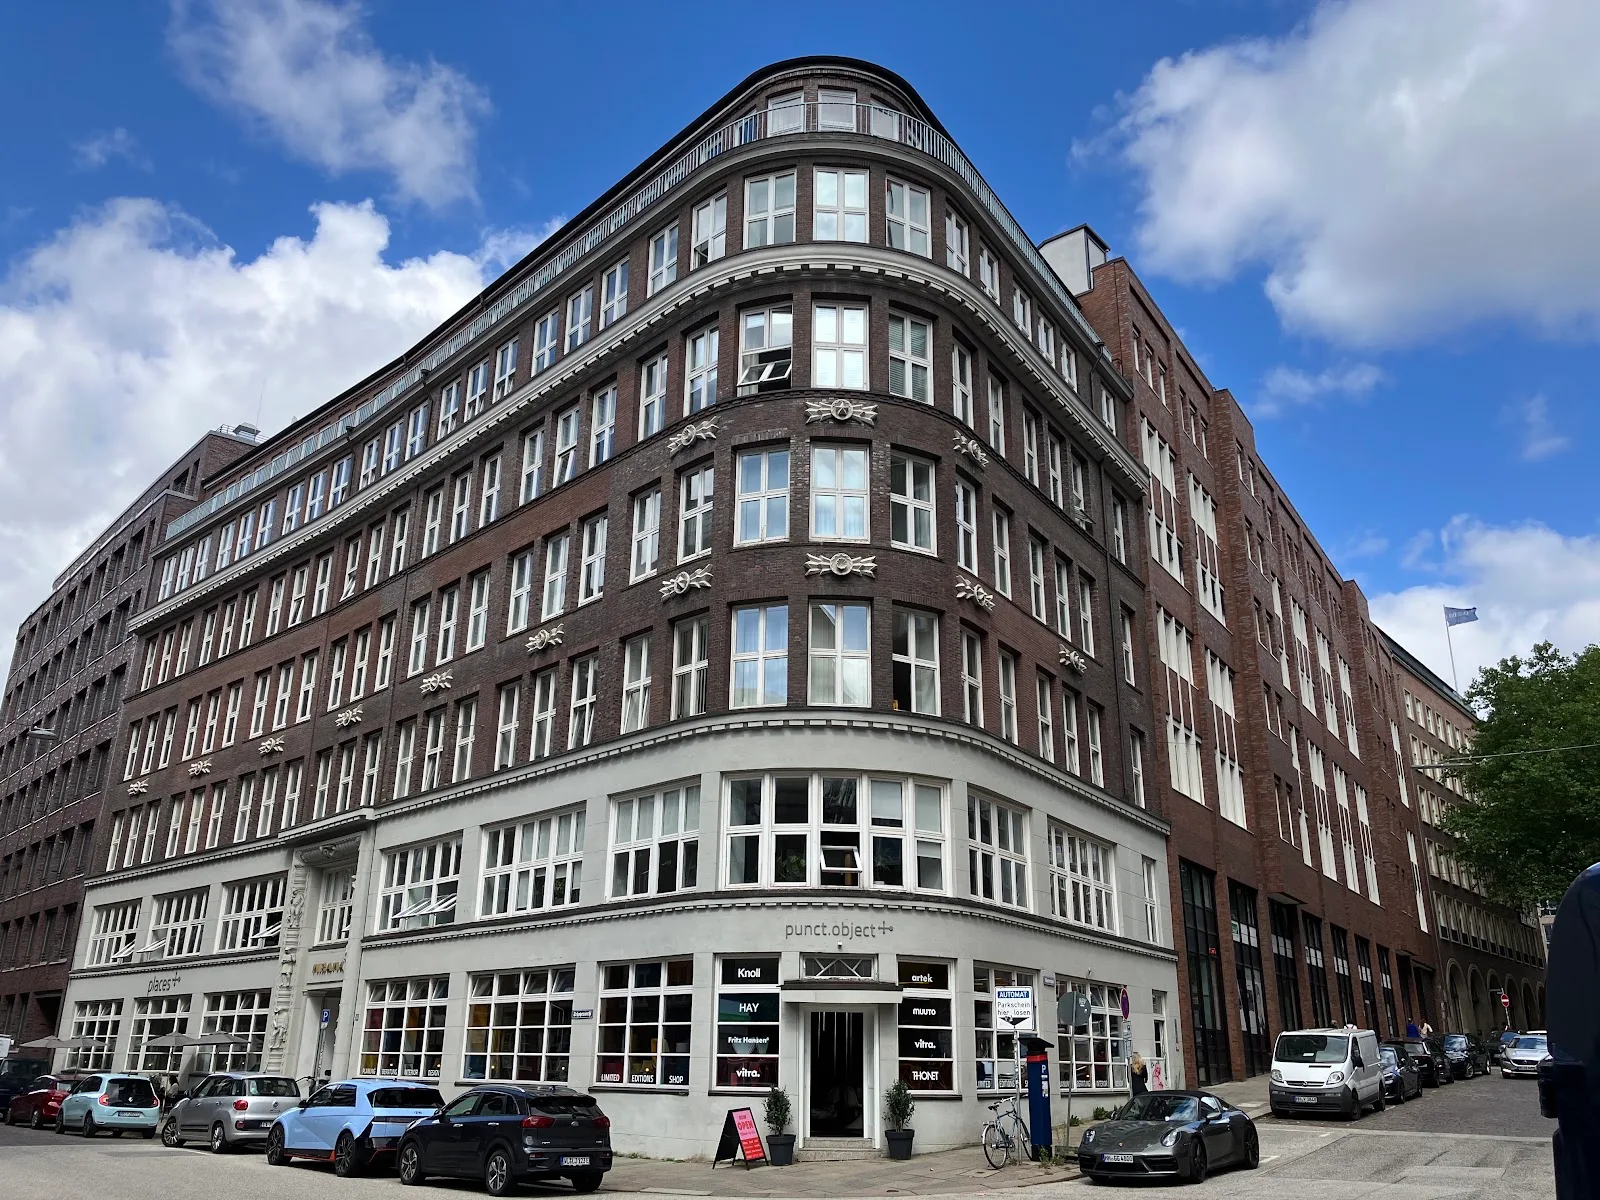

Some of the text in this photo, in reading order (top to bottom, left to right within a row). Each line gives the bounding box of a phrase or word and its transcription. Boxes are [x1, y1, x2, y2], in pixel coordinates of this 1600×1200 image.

[785, 922, 876, 940] punct.object
[737, 968, 761, 978] Knoll
[911, 973, 934, 983] artek
[146, 976, 171, 997] places
[739, 1003, 760, 1013] HAY
[997, 1001, 1031, 1009] Parkschein
[600, 1073, 684, 1084] LIMITED EDITIONS SHOP
[911, 1071, 940, 1081] THONET
[737, 1120, 754, 1131] OPEN
